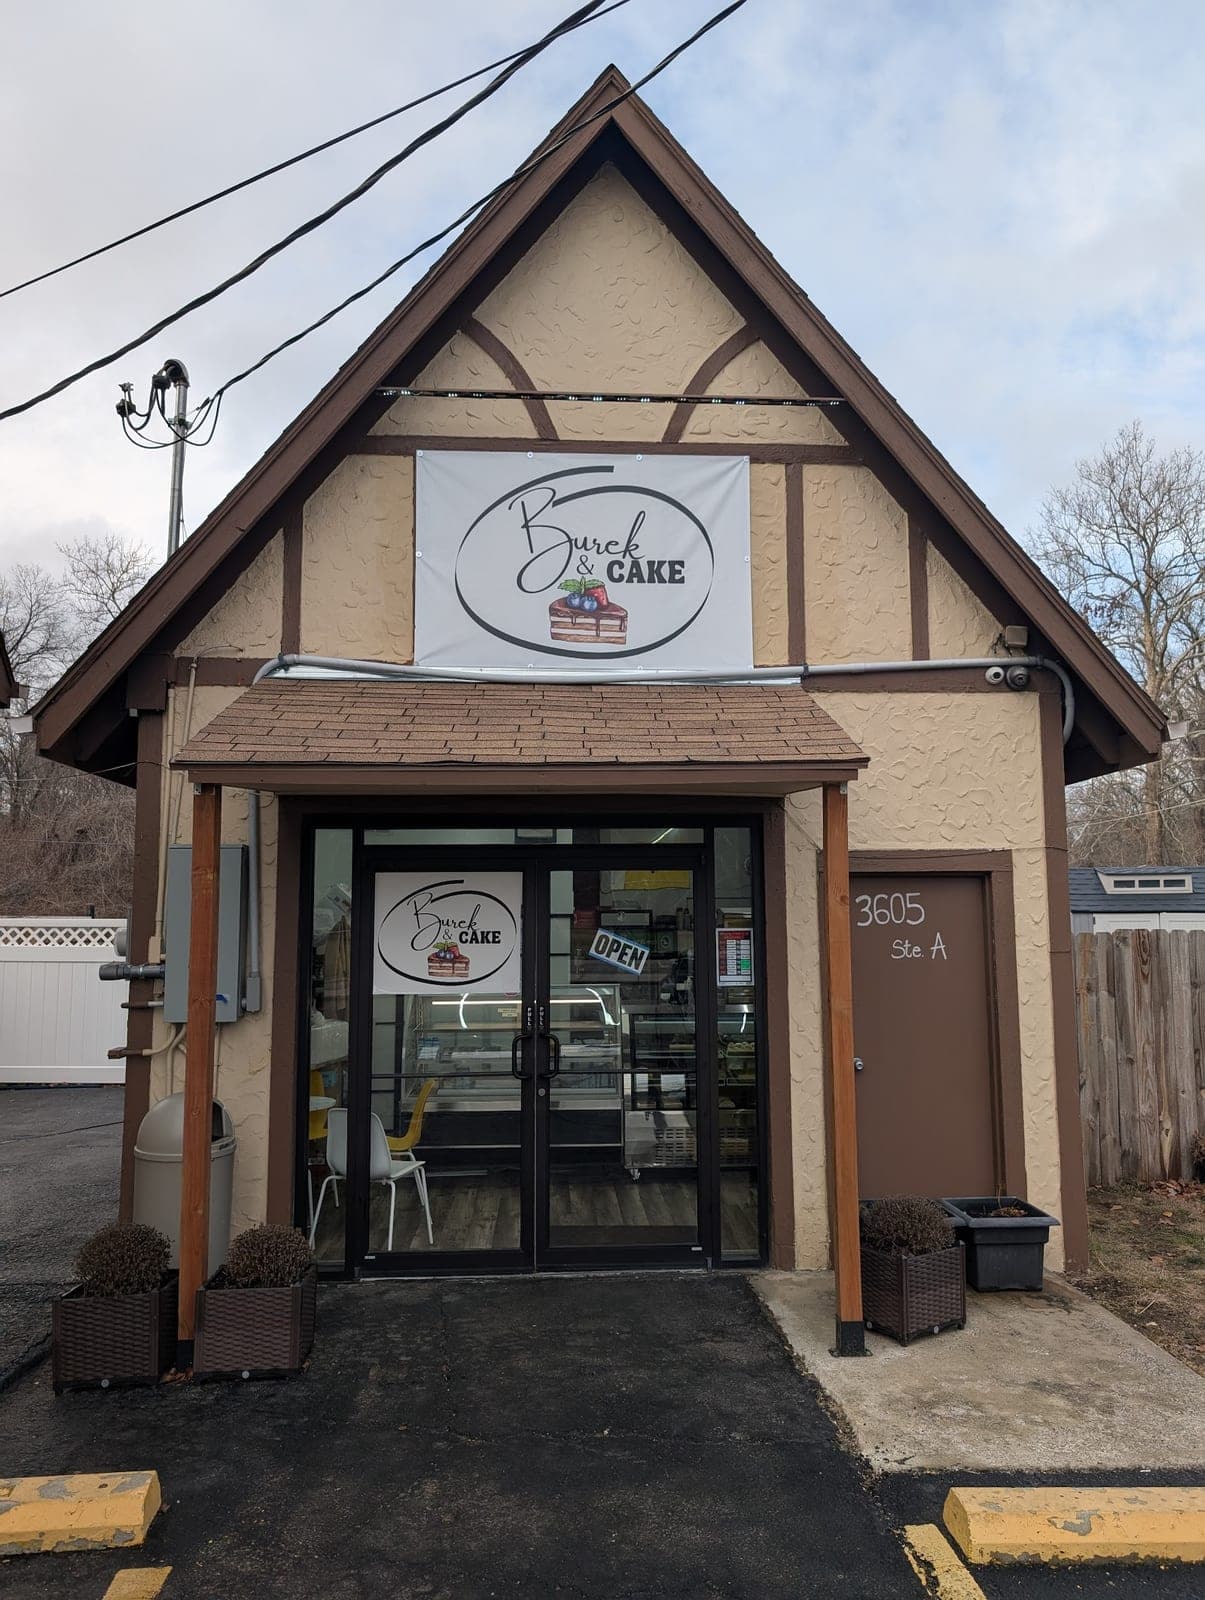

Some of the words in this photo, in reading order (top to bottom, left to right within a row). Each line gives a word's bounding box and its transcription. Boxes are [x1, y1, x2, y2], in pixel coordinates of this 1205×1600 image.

[508, 486, 646, 594] Burek
[576, 554, 594, 576] &
[606, 559, 686, 584] CAKE
[407, 892, 481, 951] Burek
[855, 892, 926, 927] 3605
[442, 929, 453, 941] &
[458, 930, 502, 945] CAKE
[594, 934, 645, 971] OPEN
[890, 939, 925, 959] Ste.
[930, 931, 947, 960] A
